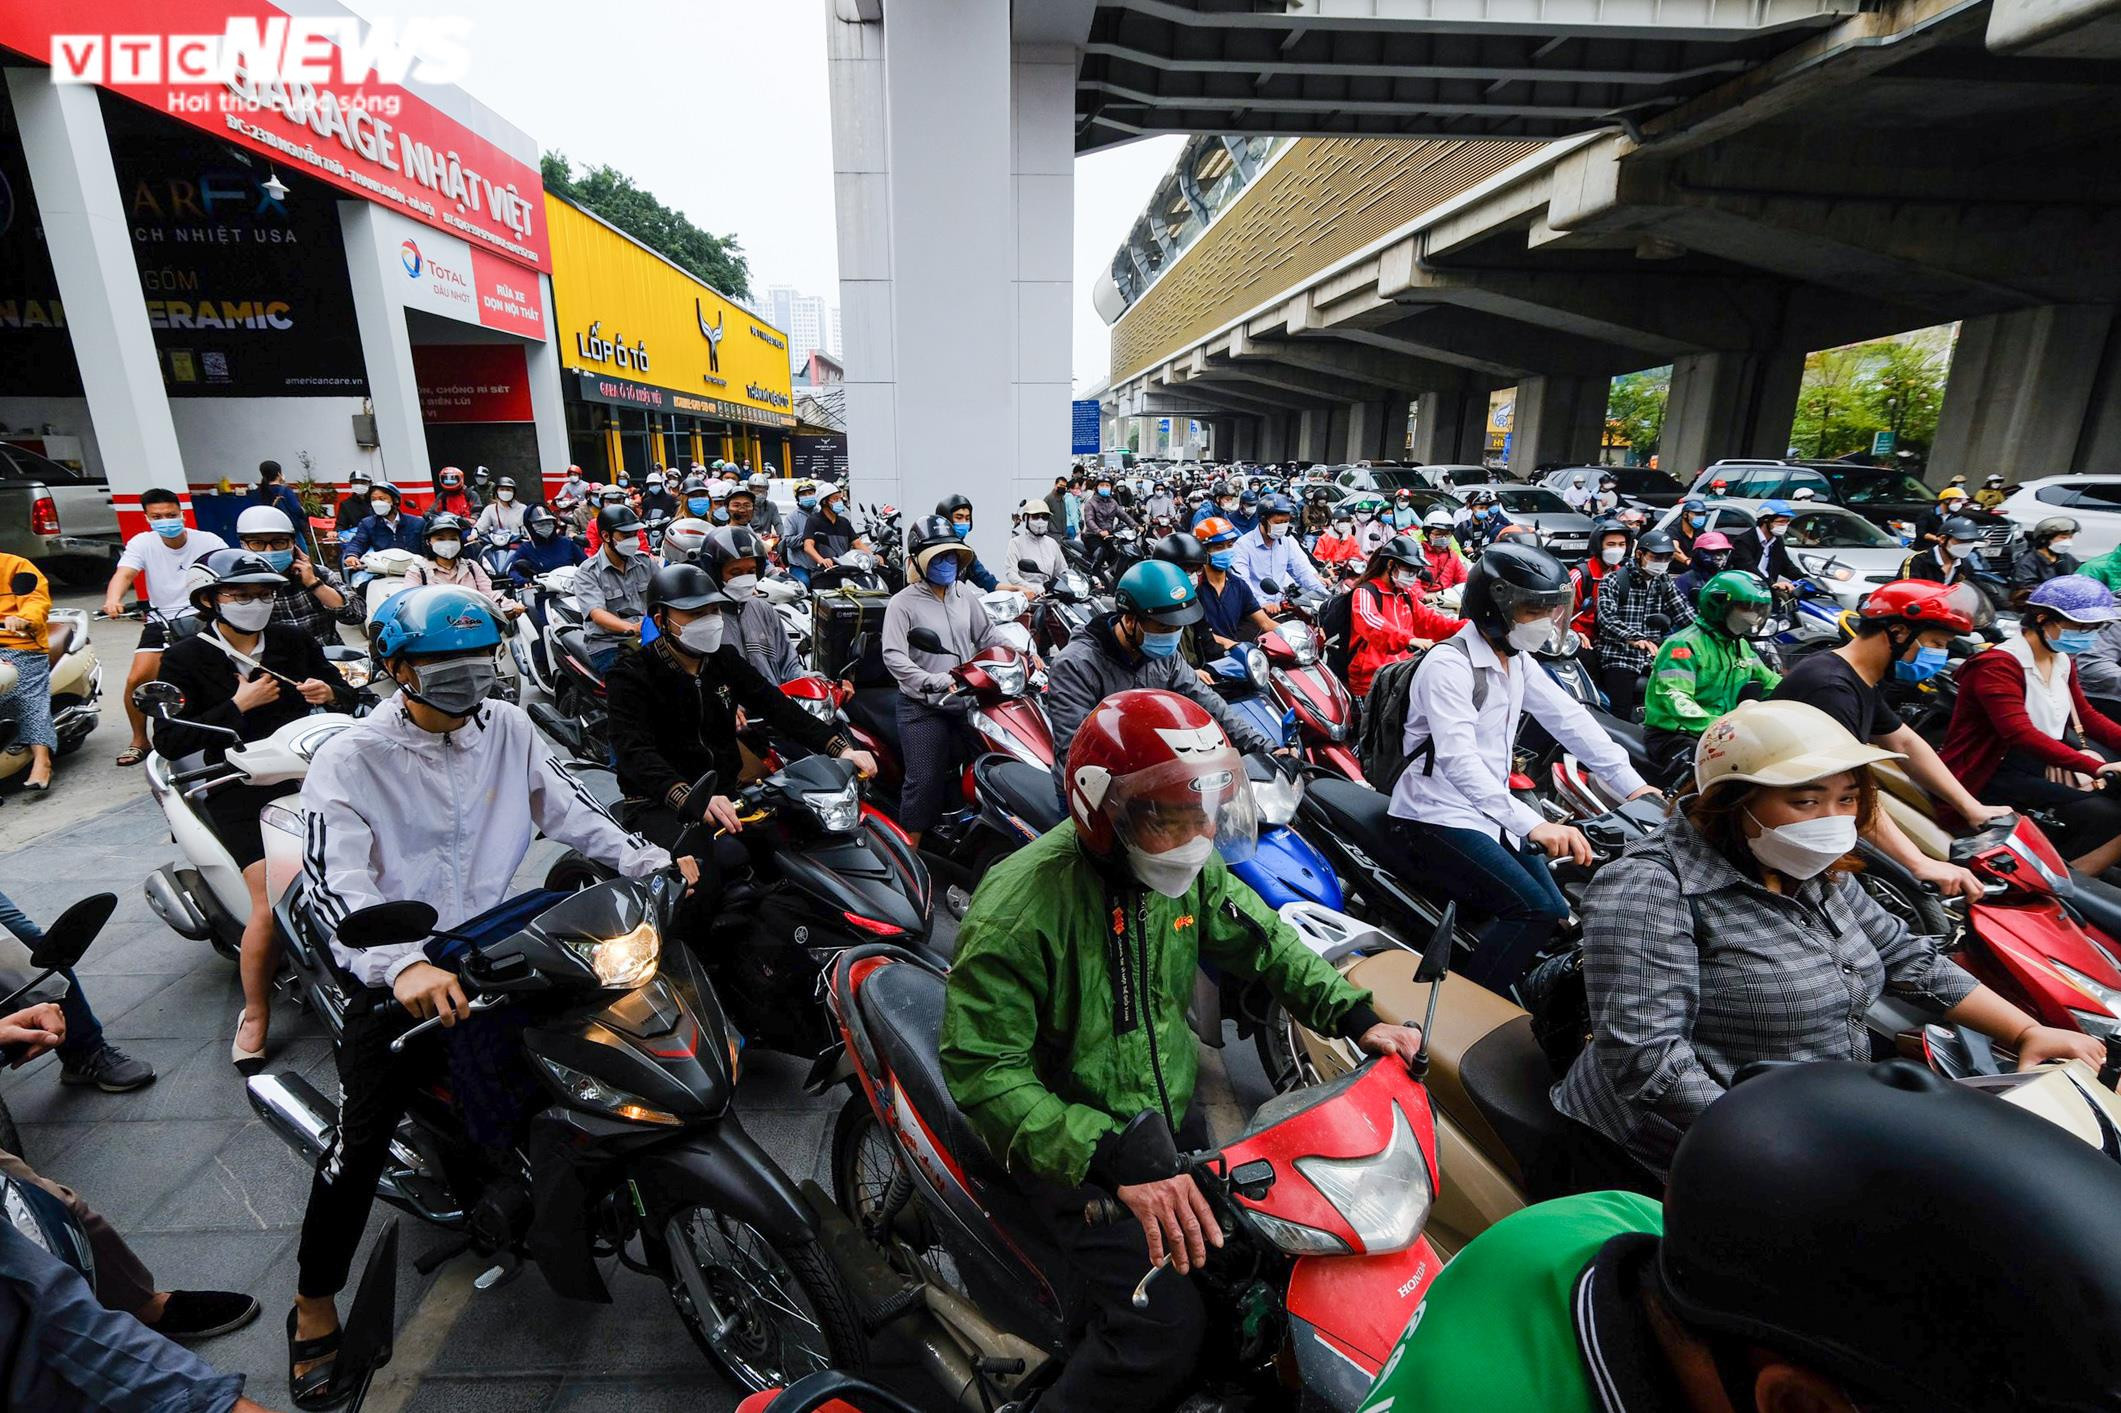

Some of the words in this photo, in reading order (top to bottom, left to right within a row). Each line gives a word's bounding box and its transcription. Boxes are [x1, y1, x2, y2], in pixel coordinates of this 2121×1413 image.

[399, 132, 482, 214] NHẬT
[482, 178, 533, 241] VIỆT
[176, 226, 242, 245] NHIỆT
[254, 229, 297, 243] USA
[514, 290, 526, 304] XE
[578, 320, 613, 362] LỐP
[616, 332, 628, 367] Ô
[629, 340, 649, 372] TÔ
[285, 376, 363, 385] americancare.vn
[1397, 1262, 1426, 1298] HONDA
